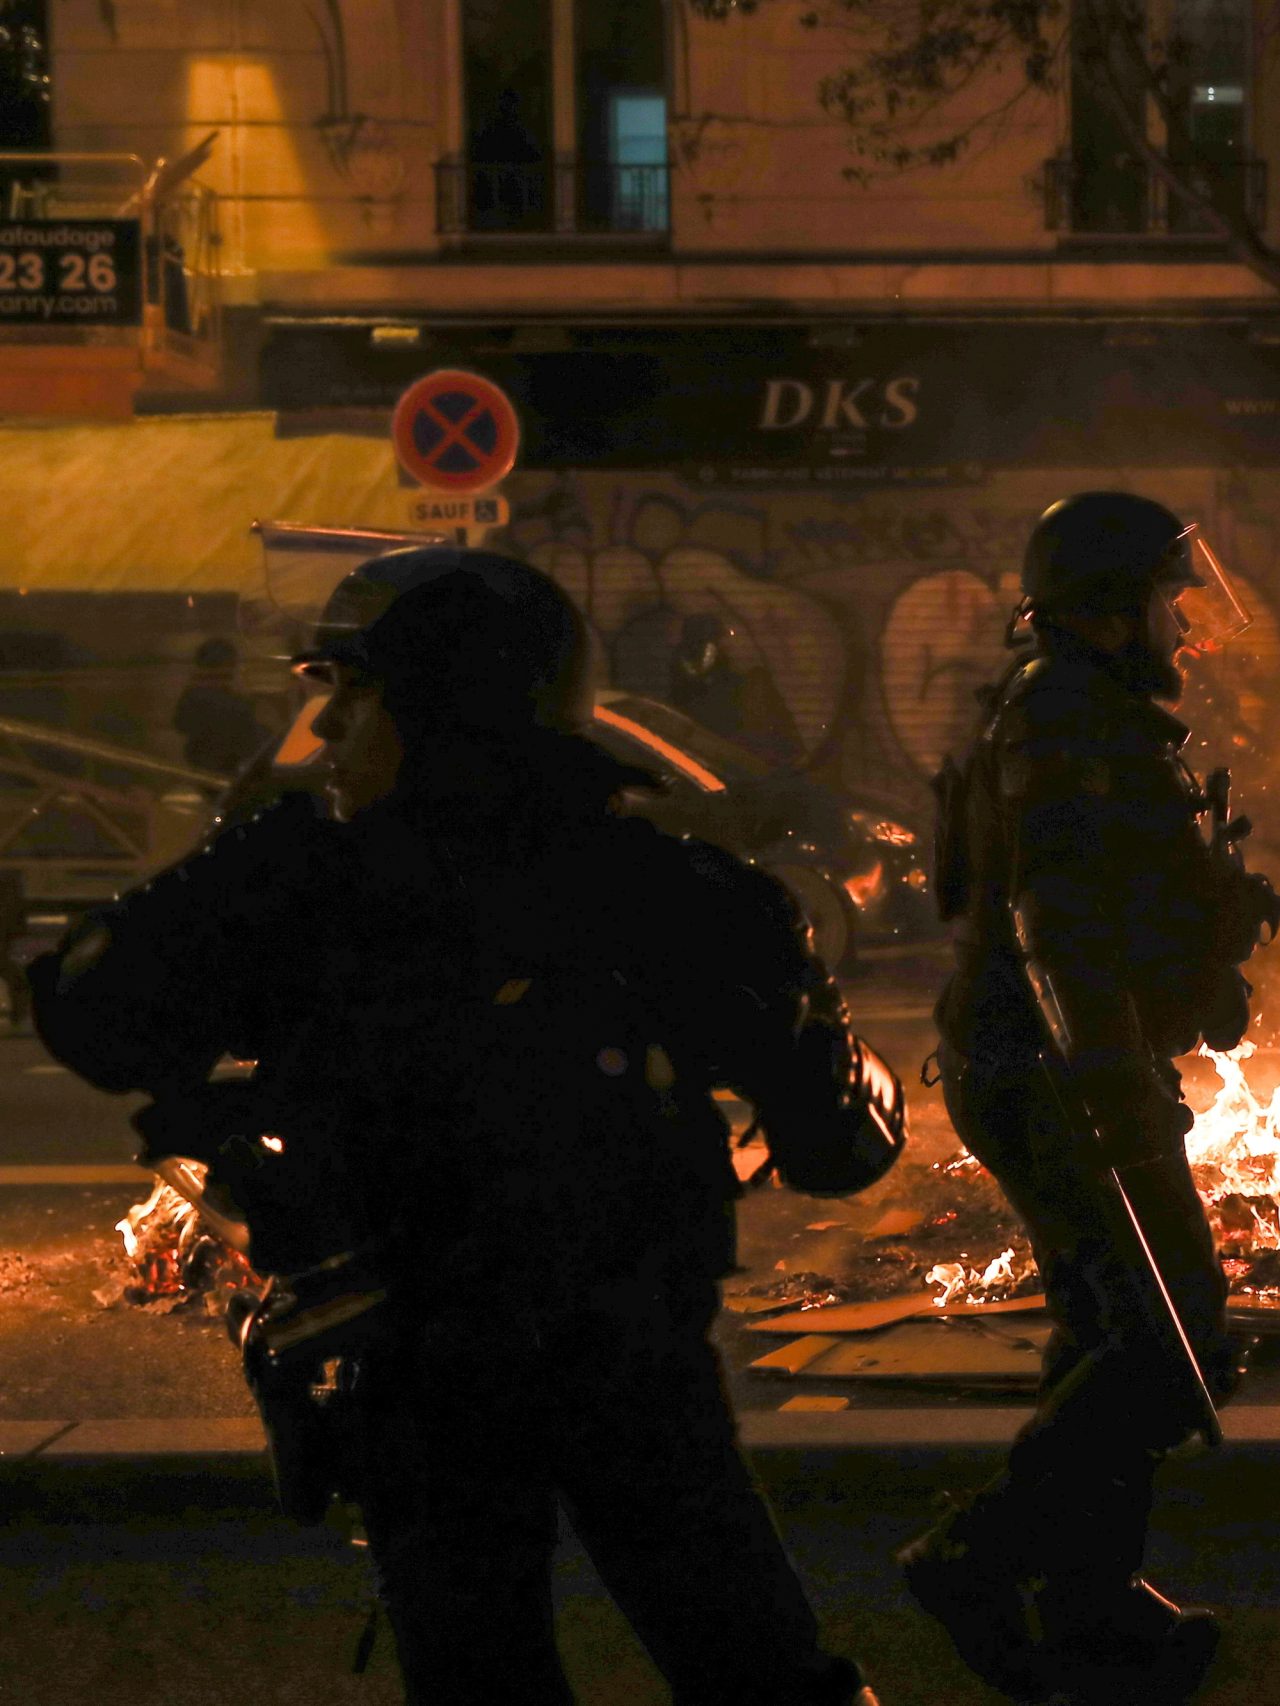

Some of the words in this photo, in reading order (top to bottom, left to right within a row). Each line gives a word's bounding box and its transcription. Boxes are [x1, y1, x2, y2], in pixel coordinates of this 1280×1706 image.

[0, 253, 44, 290] 23
[61, 253, 118, 292] 26
[757, 376, 921, 431] DKS
[415, 502, 470, 520] SAUF
